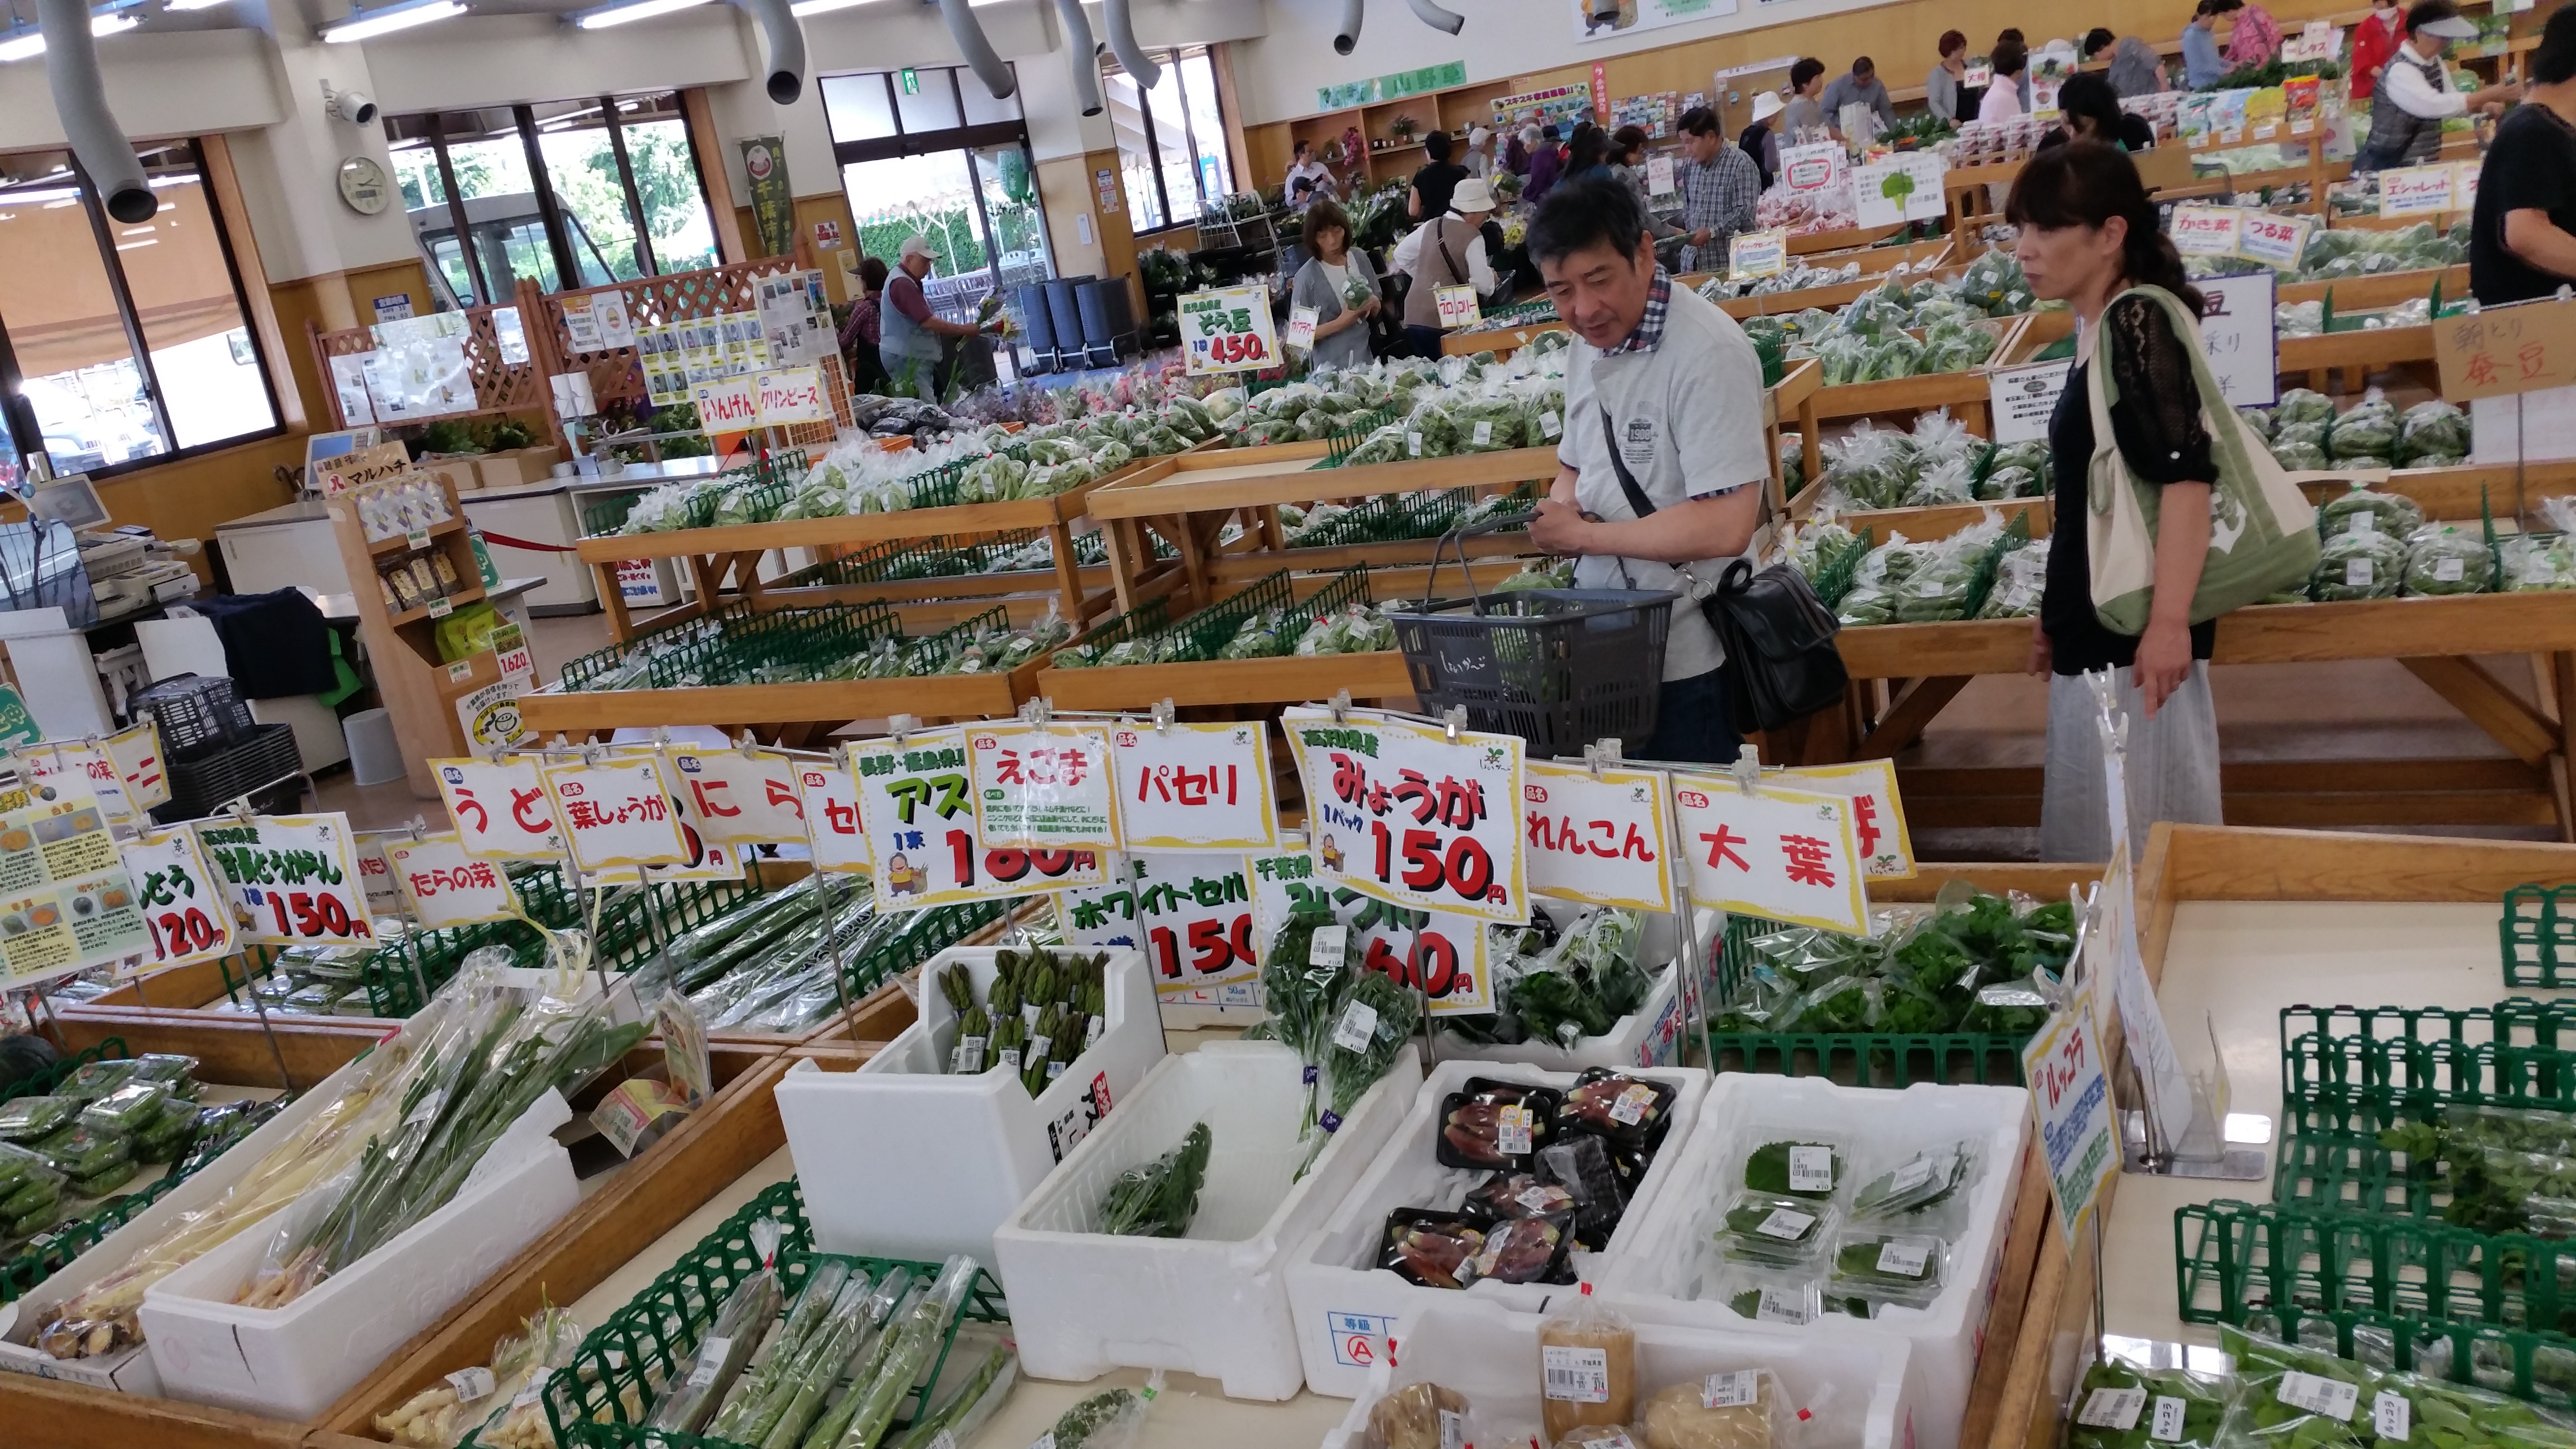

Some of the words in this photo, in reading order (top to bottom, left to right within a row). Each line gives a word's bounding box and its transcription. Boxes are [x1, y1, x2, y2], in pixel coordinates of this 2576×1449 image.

[703, 394, 755, 422] いんげん
[348, 459, 406, 484] マルハチ
[997, 748, 1087, 786] えごま
[1139, 764, 1237, 805] パセリ
[455, 787, 552, 834] うど
[567, 794, 667, 830] 葉しょうが
[691, 779, 803, 819] にら
[1330, 753, 1487, 831] みょうが
[1323, 803, 1363, 833] 1パック
[1527, 810, 1655, 863] れんこん
[1699, 823, 1835, 888] 大葉
[410, 863, 496, 897] たらの芽
[2047, 1026, 2084, 1110] ルッコラ
